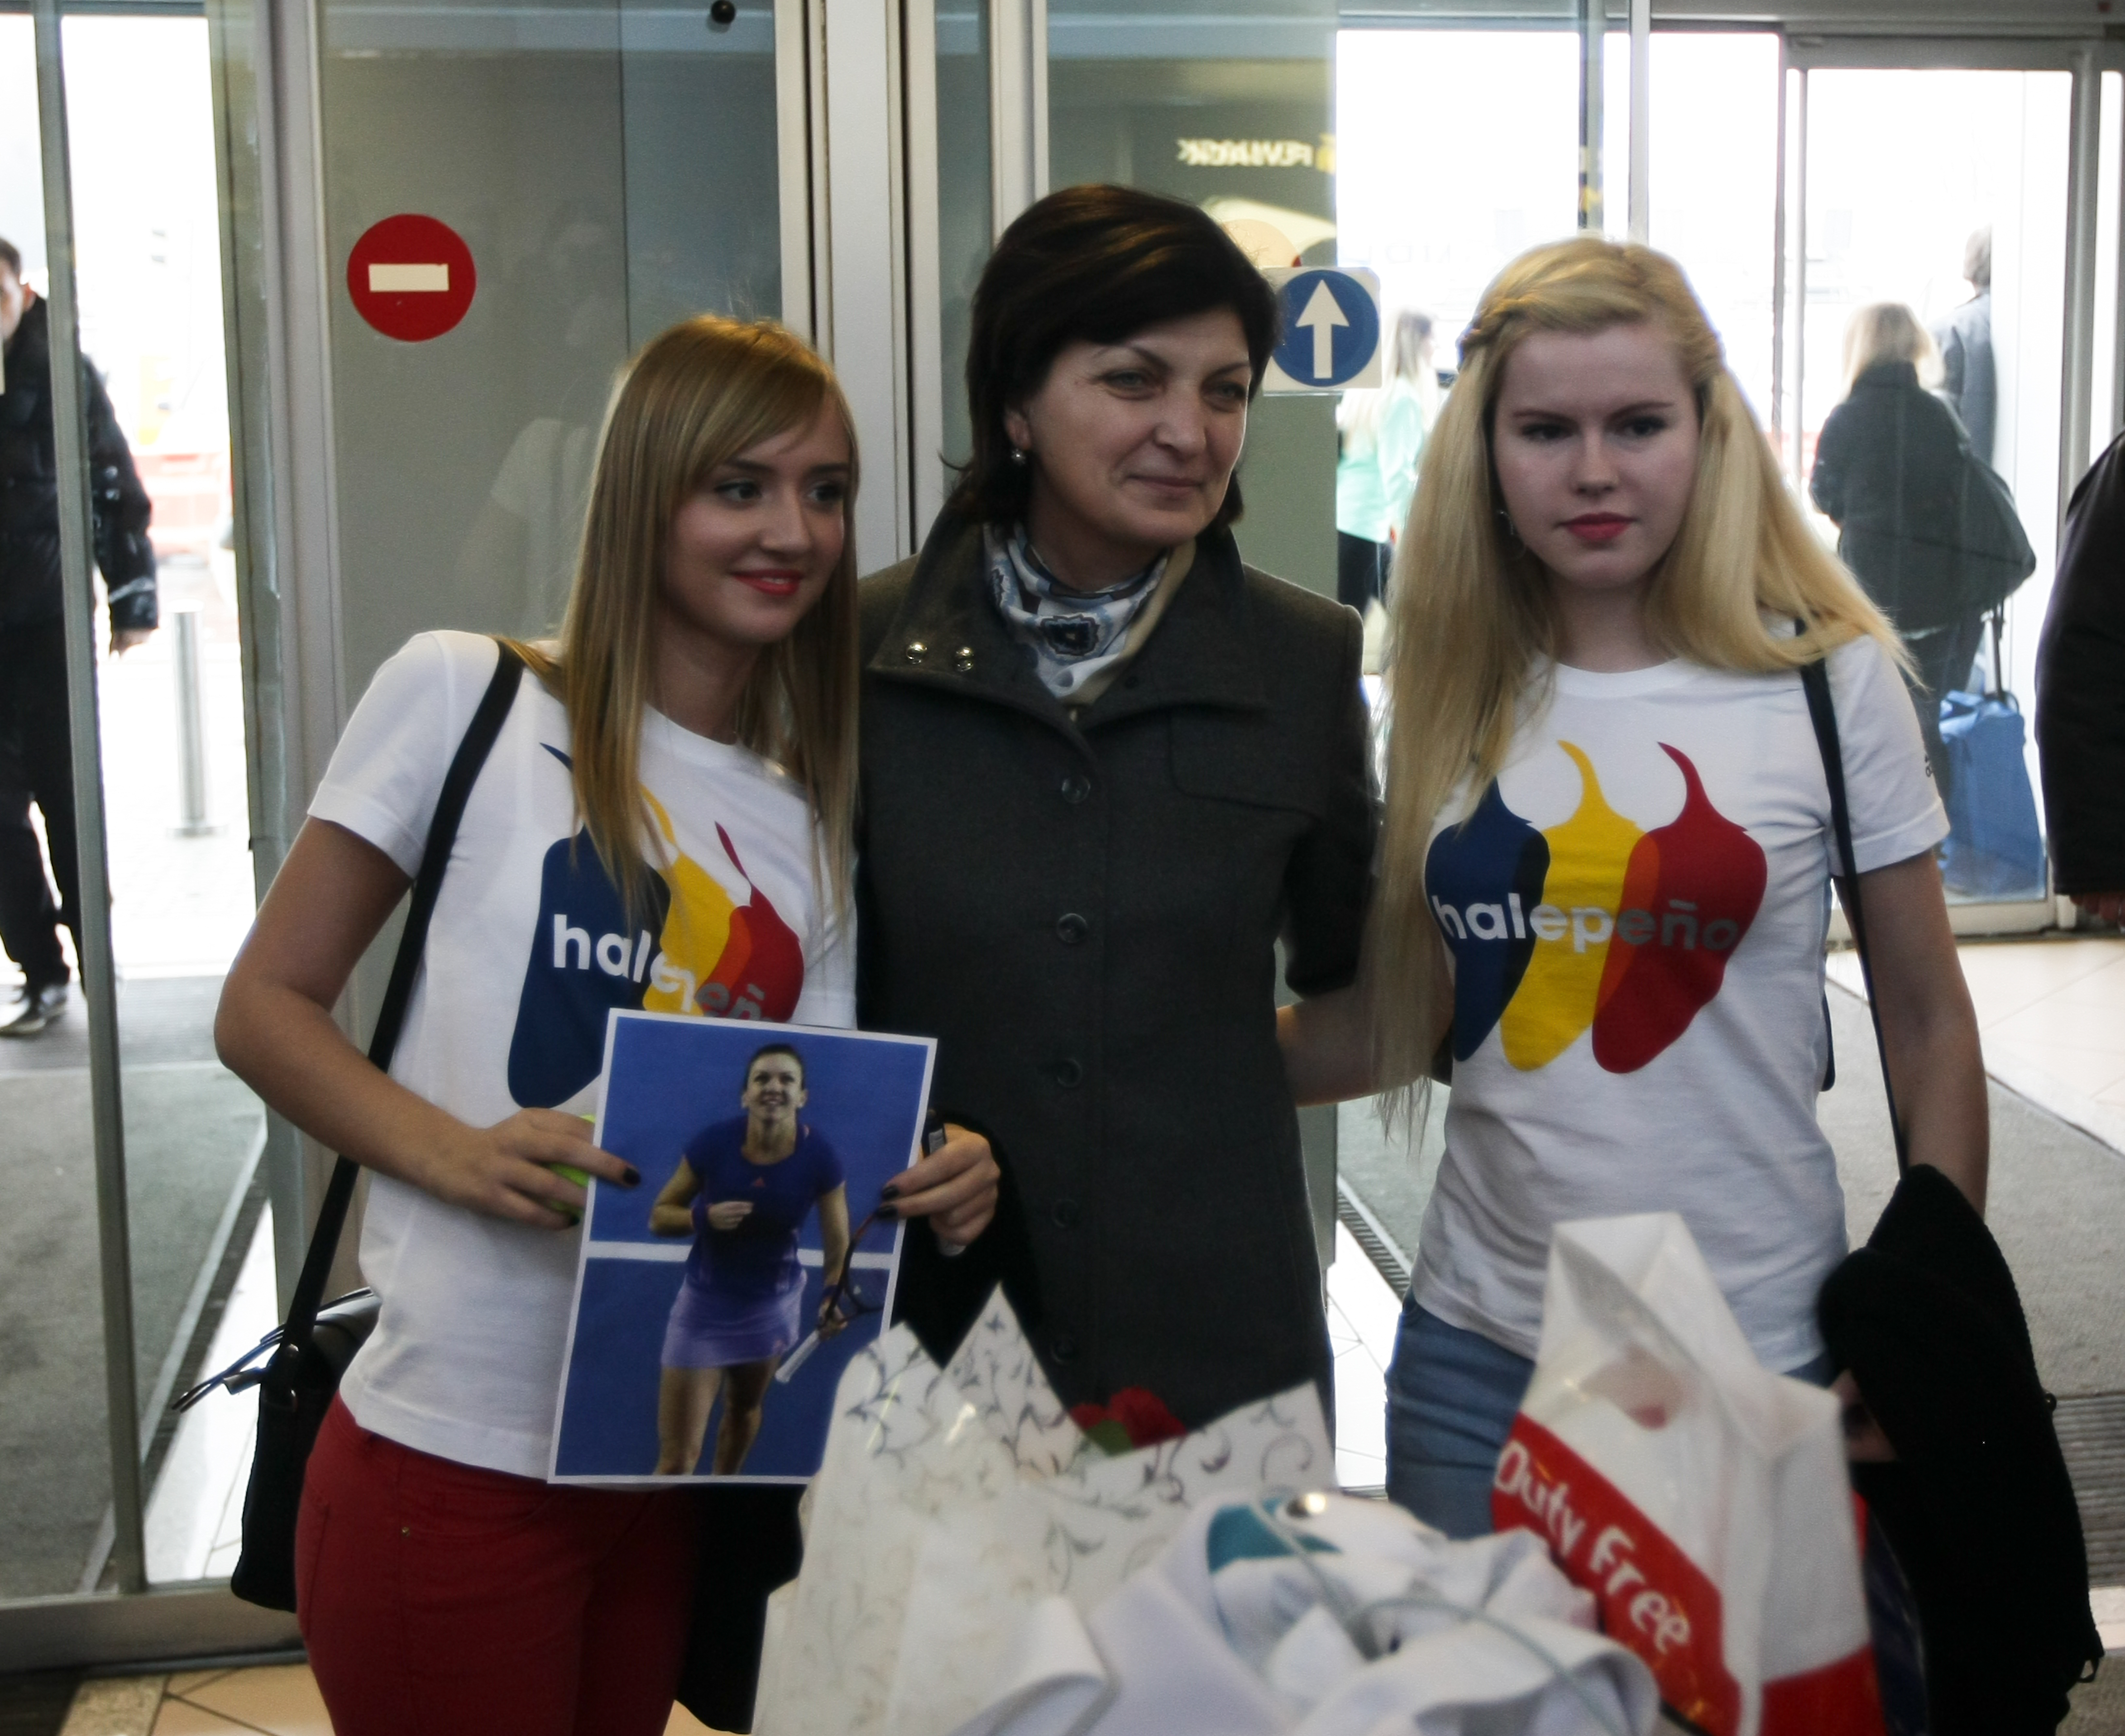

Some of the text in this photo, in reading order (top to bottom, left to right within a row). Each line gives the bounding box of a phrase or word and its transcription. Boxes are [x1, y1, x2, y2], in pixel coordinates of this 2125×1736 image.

[553, 913, 774, 1021] haleeñ
[1431, 892, 1740, 953] halepeño
[1495, 1440, 1691, 1655] Duty Free
